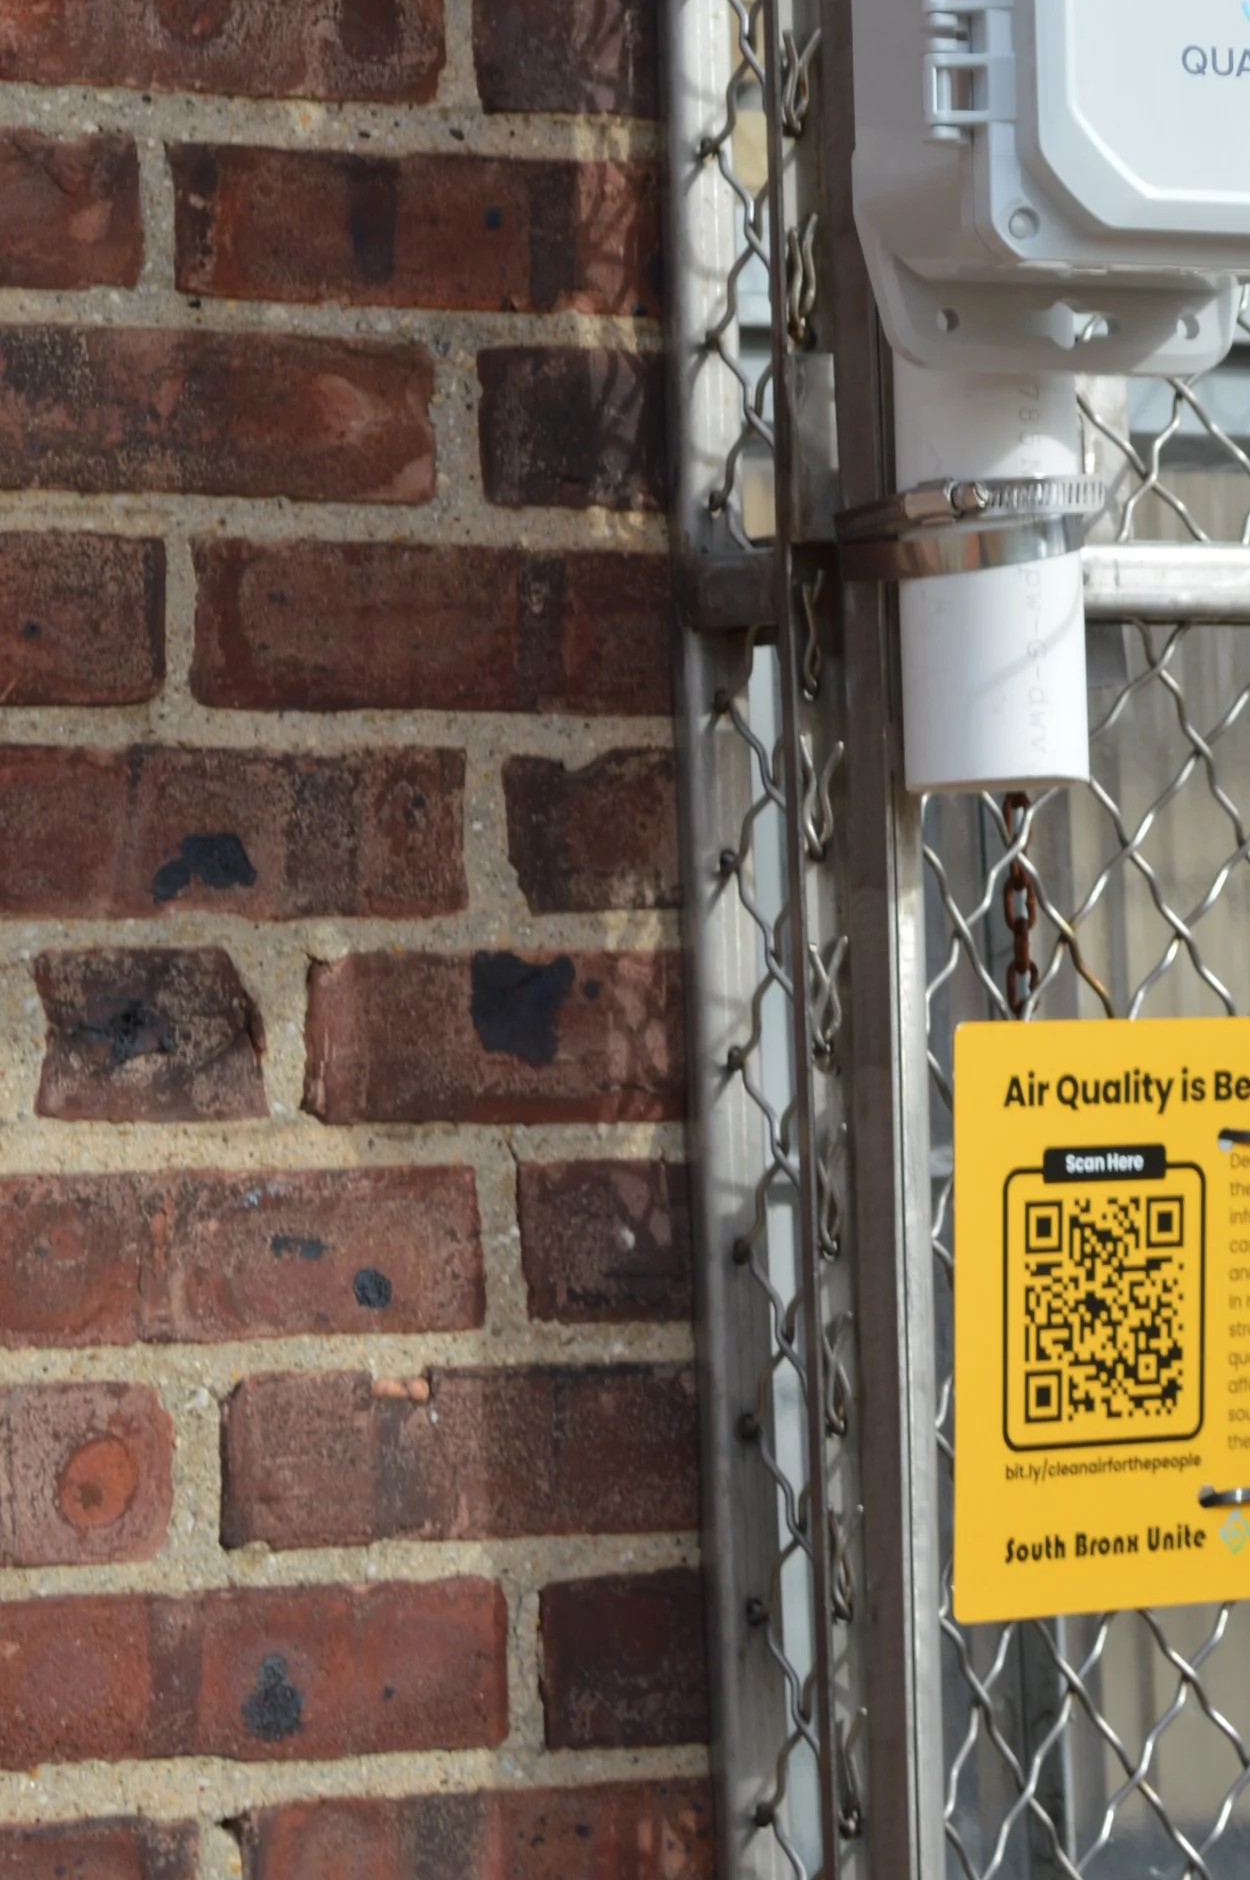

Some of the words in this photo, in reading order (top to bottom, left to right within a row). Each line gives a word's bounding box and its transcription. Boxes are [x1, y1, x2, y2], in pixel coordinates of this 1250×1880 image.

[1003, 1070, 1049, 1108] Air
[1056, 1067, 1174, 1115] Quality
[1181, 1066, 1206, 1102] is
[1065, 1153, 1104, 1174] Scan
[1107, 1152, 1145, 1171] Here
[1229, 1294, 1242, 1310] In
[1005, 1452, 1202, 1484] bit.ly/cleanairforthepeople
[1005, 1535, 1066, 1564] South
[1075, 1531, 1139, 1557] Bronx
[1147, 1524, 1206, 1552] Unite
